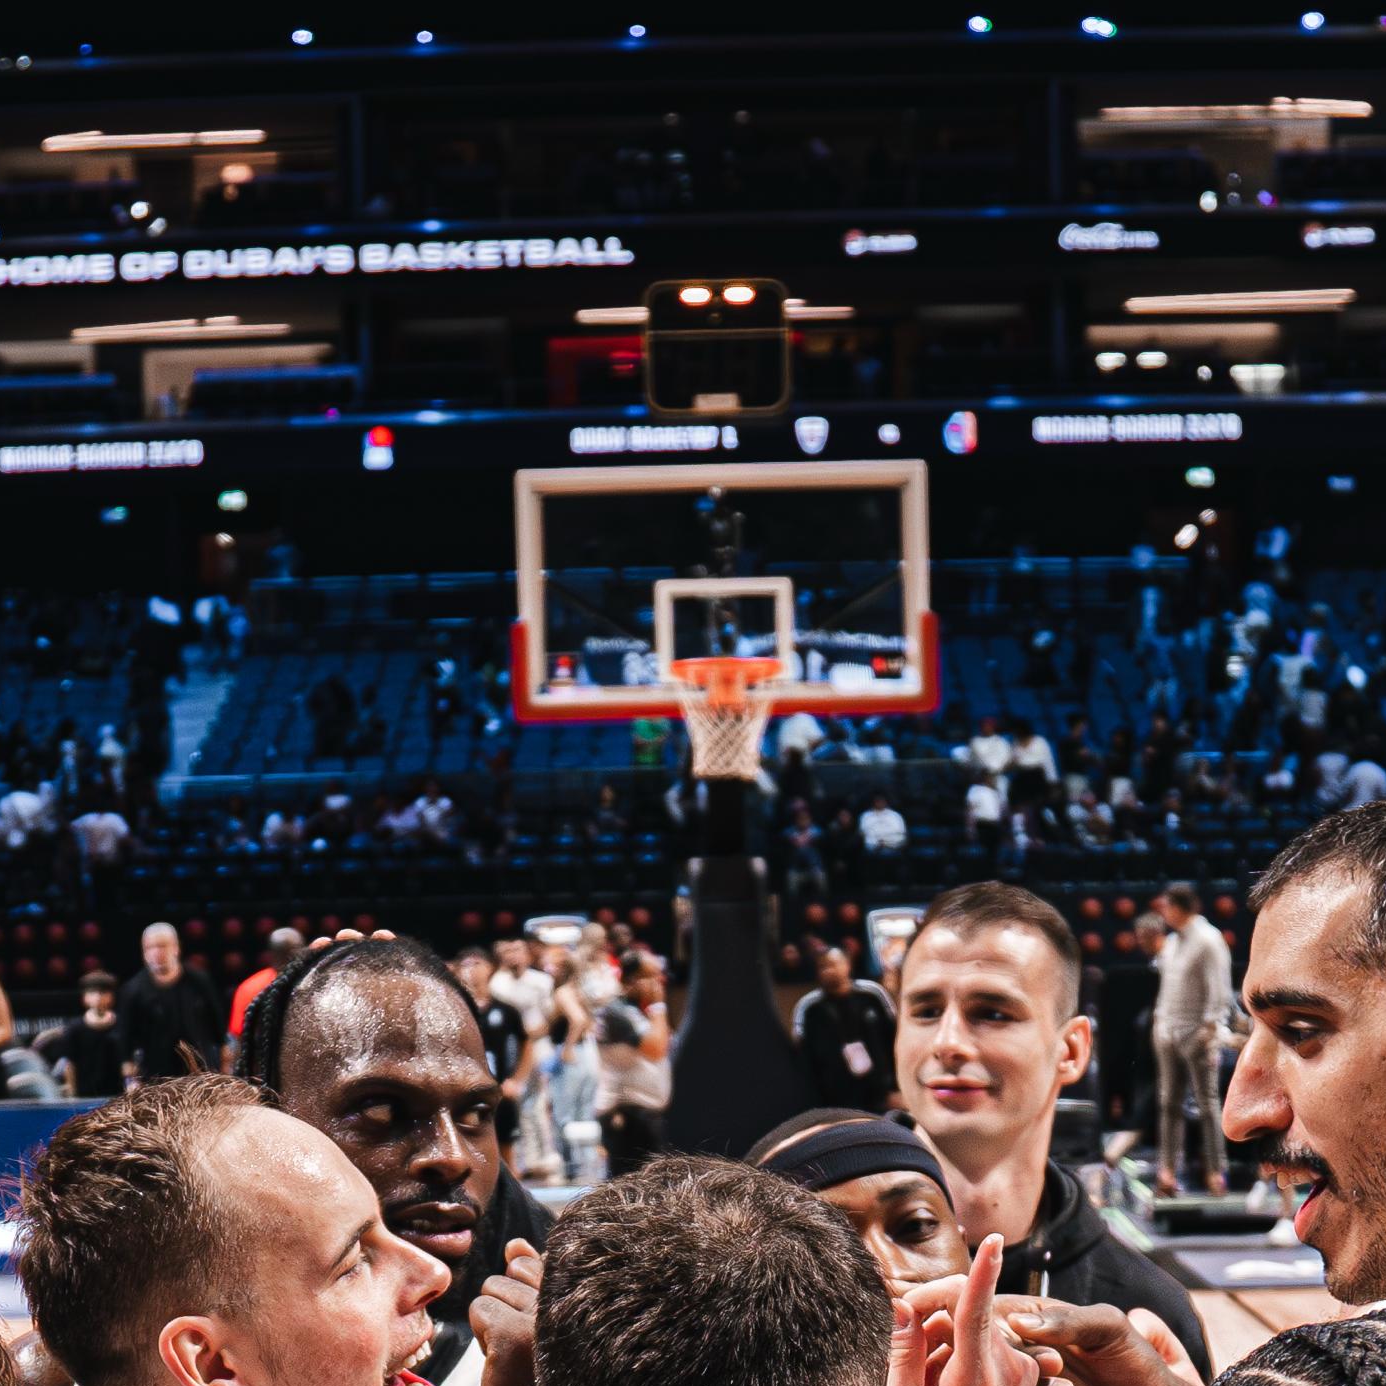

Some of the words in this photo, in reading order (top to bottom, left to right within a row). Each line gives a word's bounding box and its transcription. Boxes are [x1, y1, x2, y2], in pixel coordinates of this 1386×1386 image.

[120, 250, 179, 282] OF
[182, 244, 355, 280] DUBAI'S
[358, 236, 635, 273] BASKETBALL
